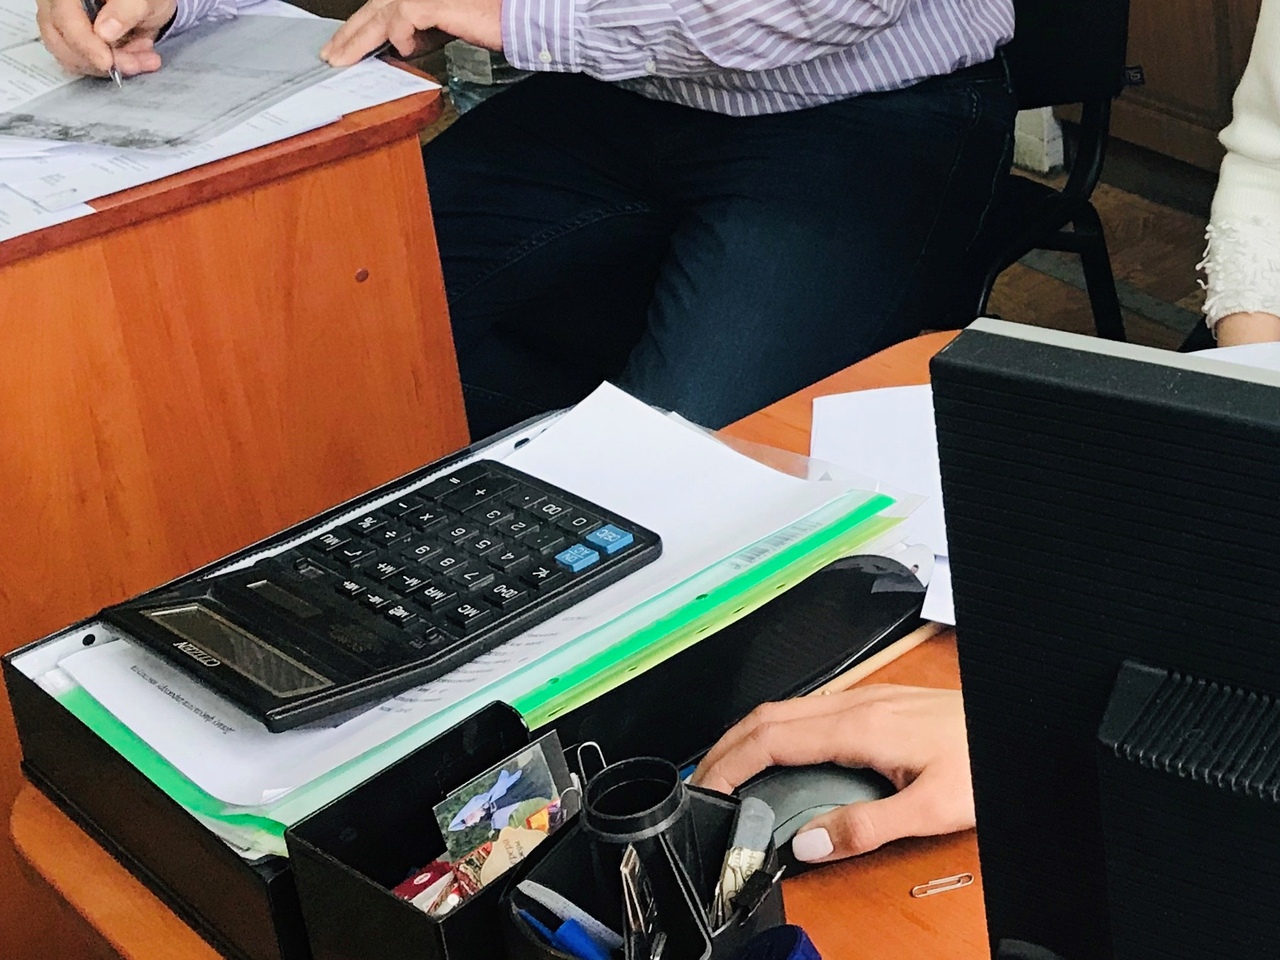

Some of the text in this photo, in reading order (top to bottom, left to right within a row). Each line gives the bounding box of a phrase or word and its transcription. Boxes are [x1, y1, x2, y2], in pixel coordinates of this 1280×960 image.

[486, 510, 501, 519] 3
[510, 522, 526, 531] 2
[572, 517, 587, 527] 0
[451, 527, 466, 537] 6
[320, 534, 341, 545] MU
[475, 539, 492, 550] 5
[415, 545, 430, 554] 9
[500, 551, 515, 560] 4
[440, 557, 455, 567] 8
[377, 563, 396, 574] M+
[402, 575, 421, 587] M-
[463, 572, 479, 581] 7
[424, 587, 446, 600] MR
[457, 604, 480, 617] MC
[173, 641, 222, 667] CITIZEN
